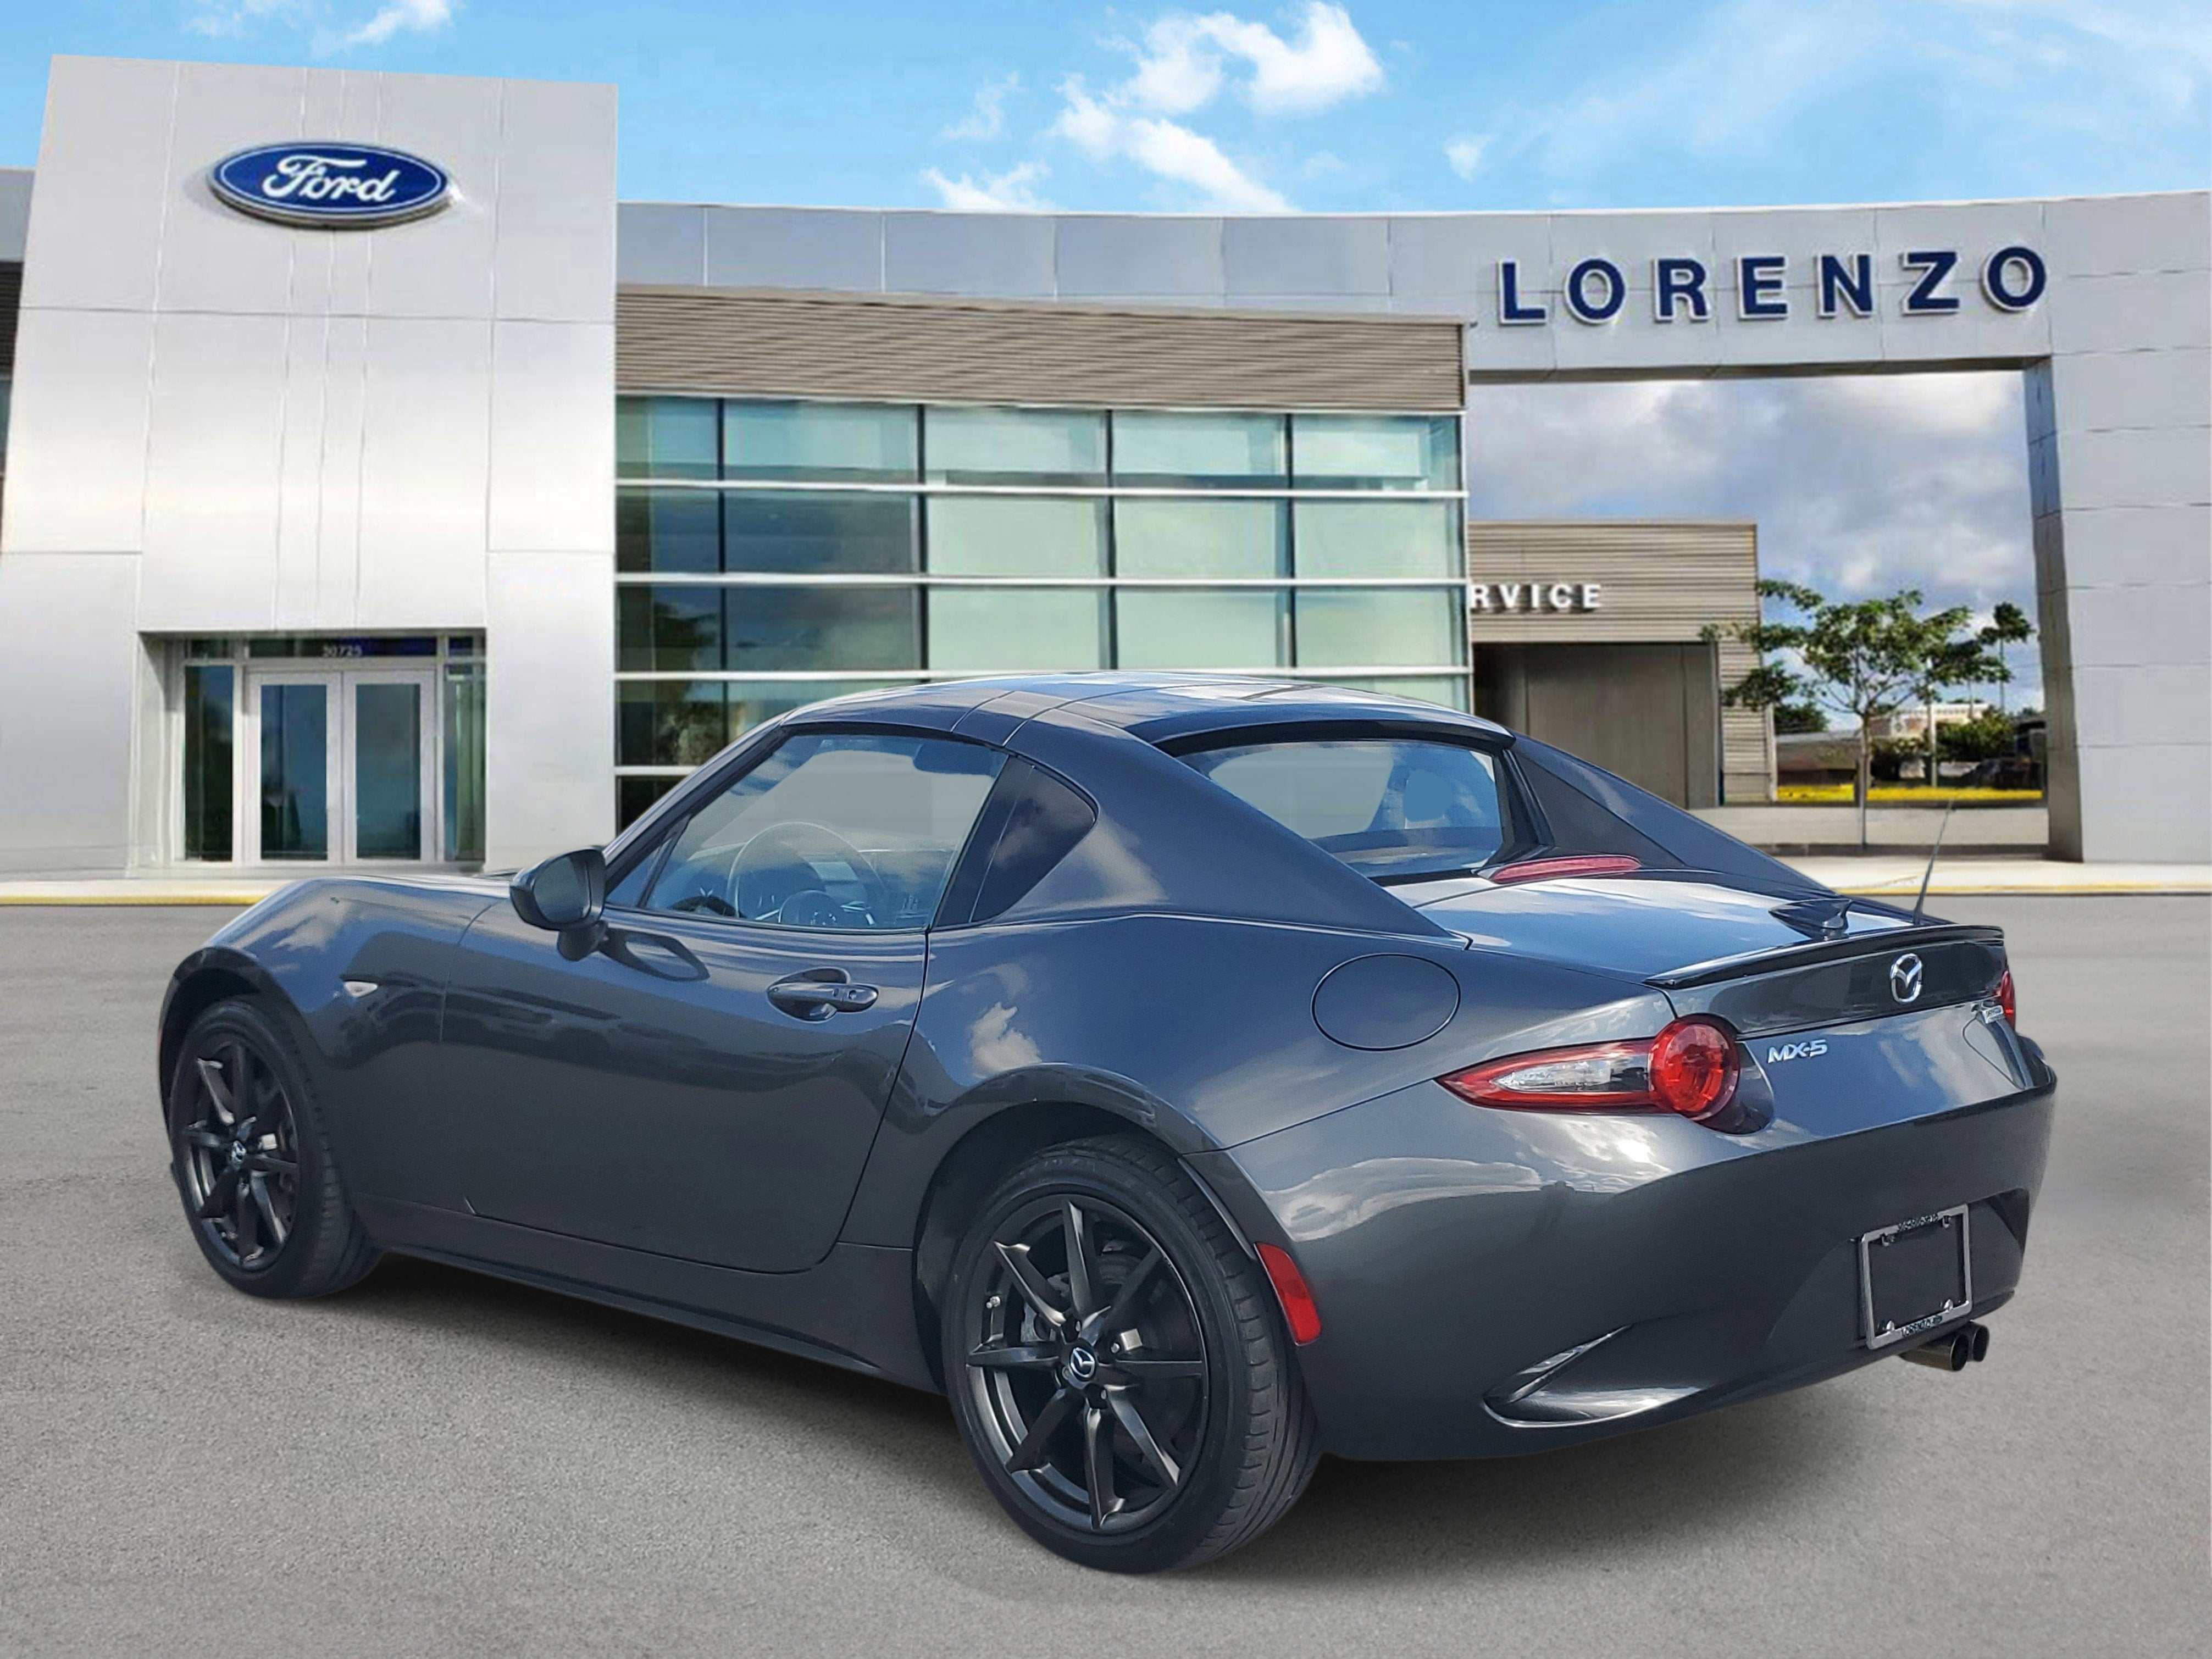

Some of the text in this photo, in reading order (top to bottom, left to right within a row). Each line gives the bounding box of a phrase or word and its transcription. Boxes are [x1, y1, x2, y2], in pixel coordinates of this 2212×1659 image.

[262, 154, 401, 202] Ford
[1499, 246, 2047, 324] LORENZO
[1470, 584, 1601, 608] RVICE
[1767, 1039, 1828, 1063] MX-5
